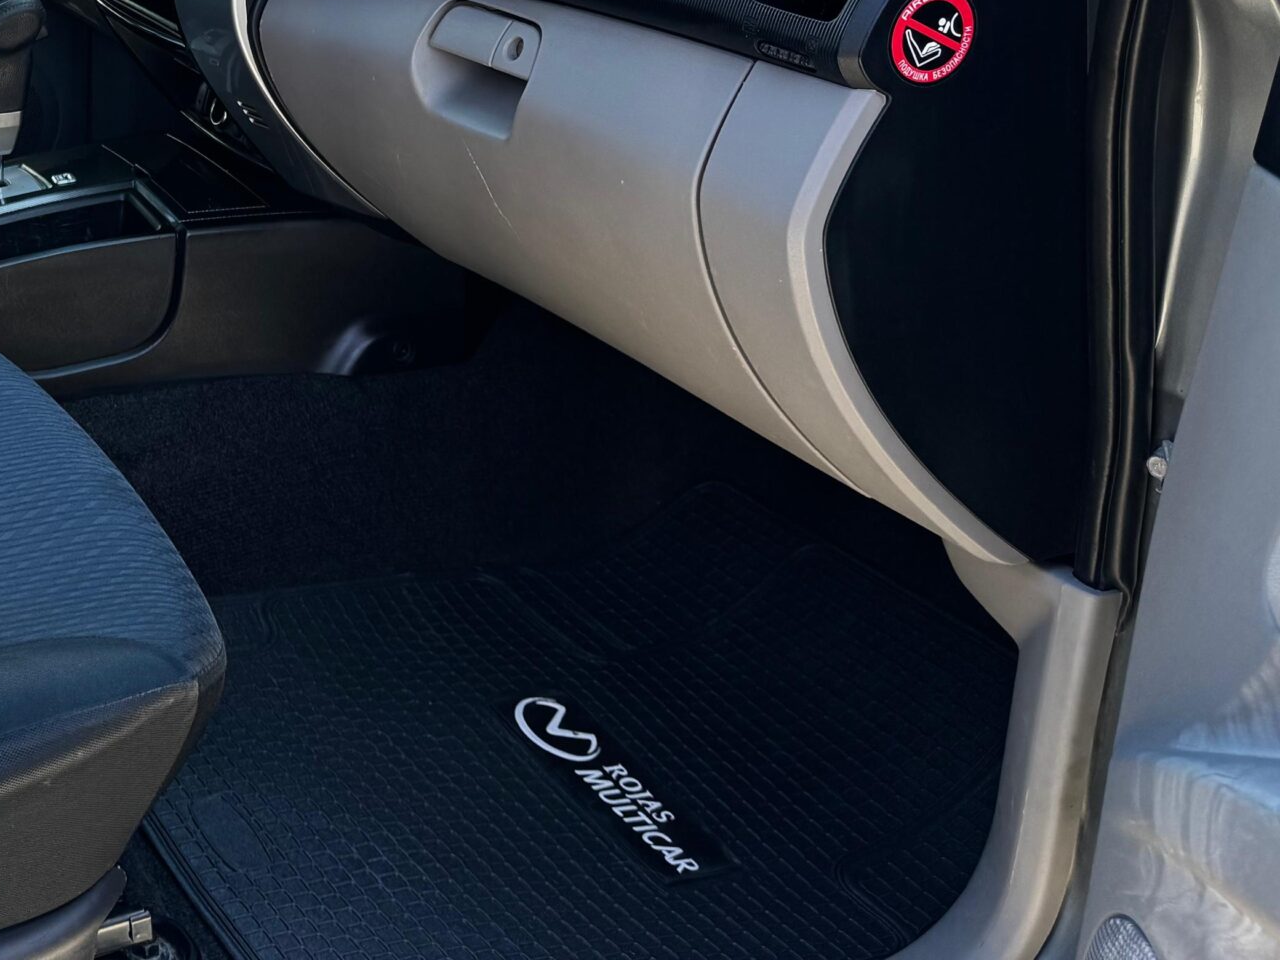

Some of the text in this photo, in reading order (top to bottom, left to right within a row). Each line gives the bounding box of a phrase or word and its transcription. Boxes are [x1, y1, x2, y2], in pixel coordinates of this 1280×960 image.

[898, 25, 972, 81] ПОДУШКА БЕЗОПАСНОСТИ
[574, 769, 700, 874] MULTICAR
[603, 763, 675, 824] ROJAS
